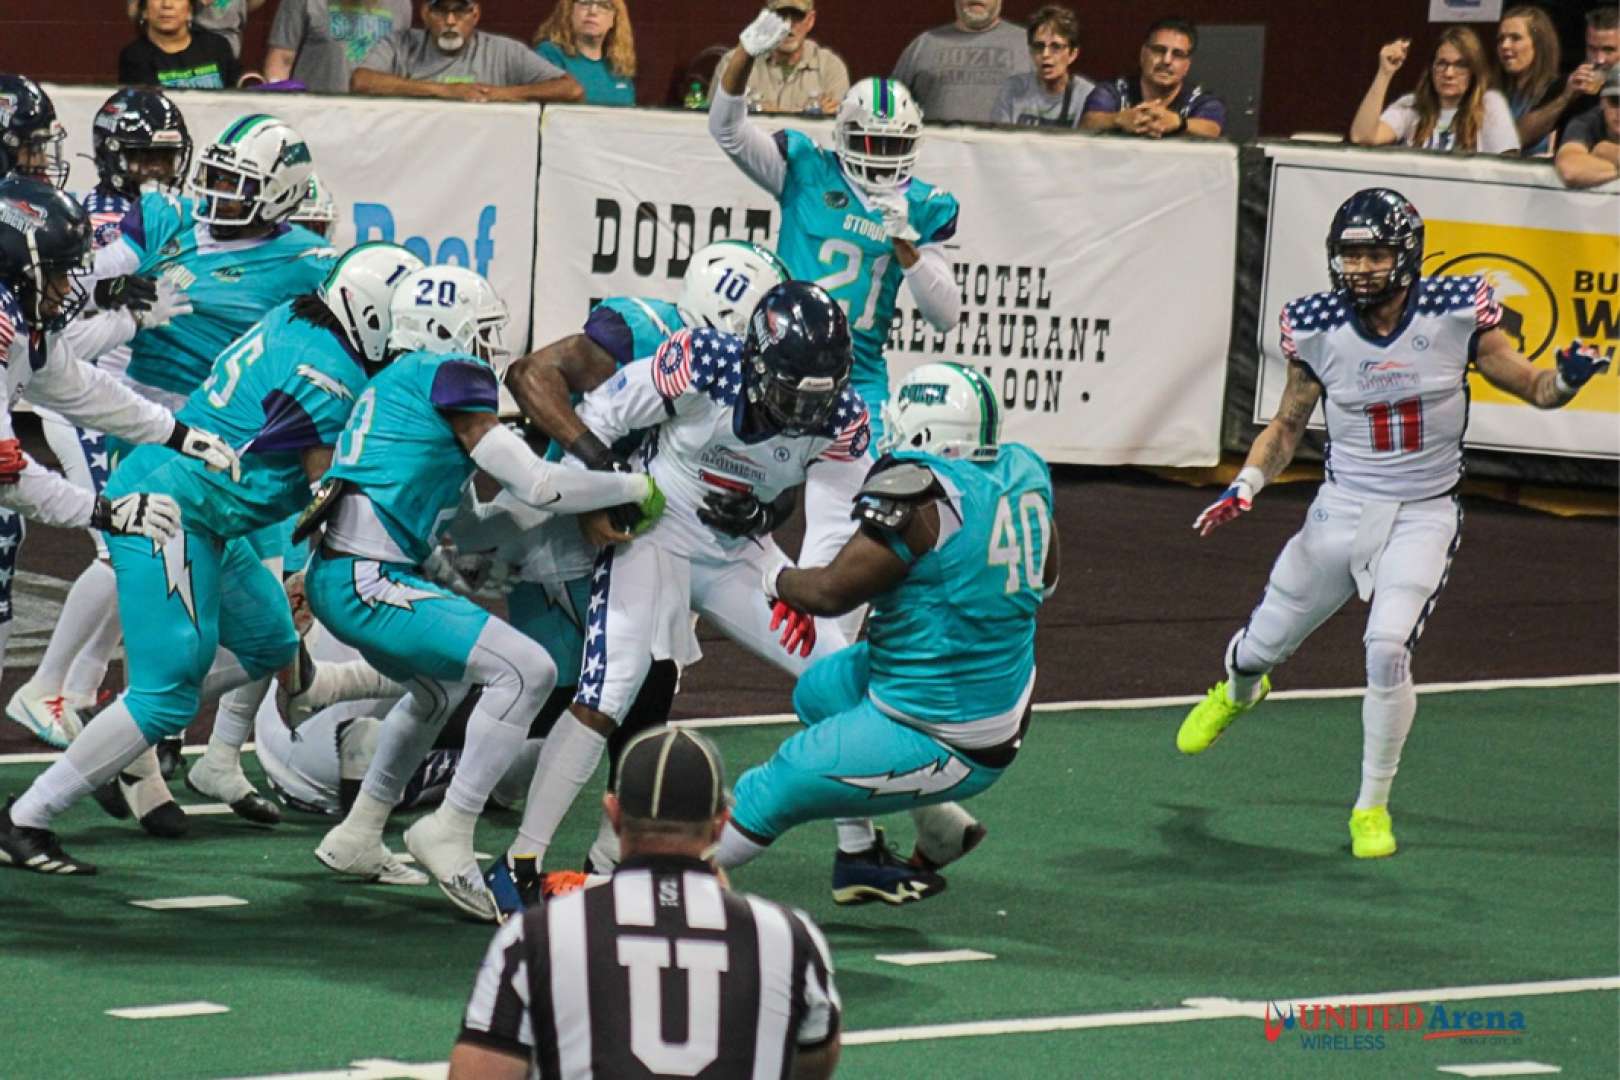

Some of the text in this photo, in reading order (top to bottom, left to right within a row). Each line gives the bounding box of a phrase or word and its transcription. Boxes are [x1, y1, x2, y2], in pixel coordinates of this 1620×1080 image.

[415, 278, 456, 307] 20
[714, 267, 751, 303] 10
[814, 238, 891, 331] 21
[953, 263, 1051, 309] HOTEL
[1364, 395, 1424, 452] 11
[988, 491, 1051, 594] 40
[616, 934, 730, 1078] U
